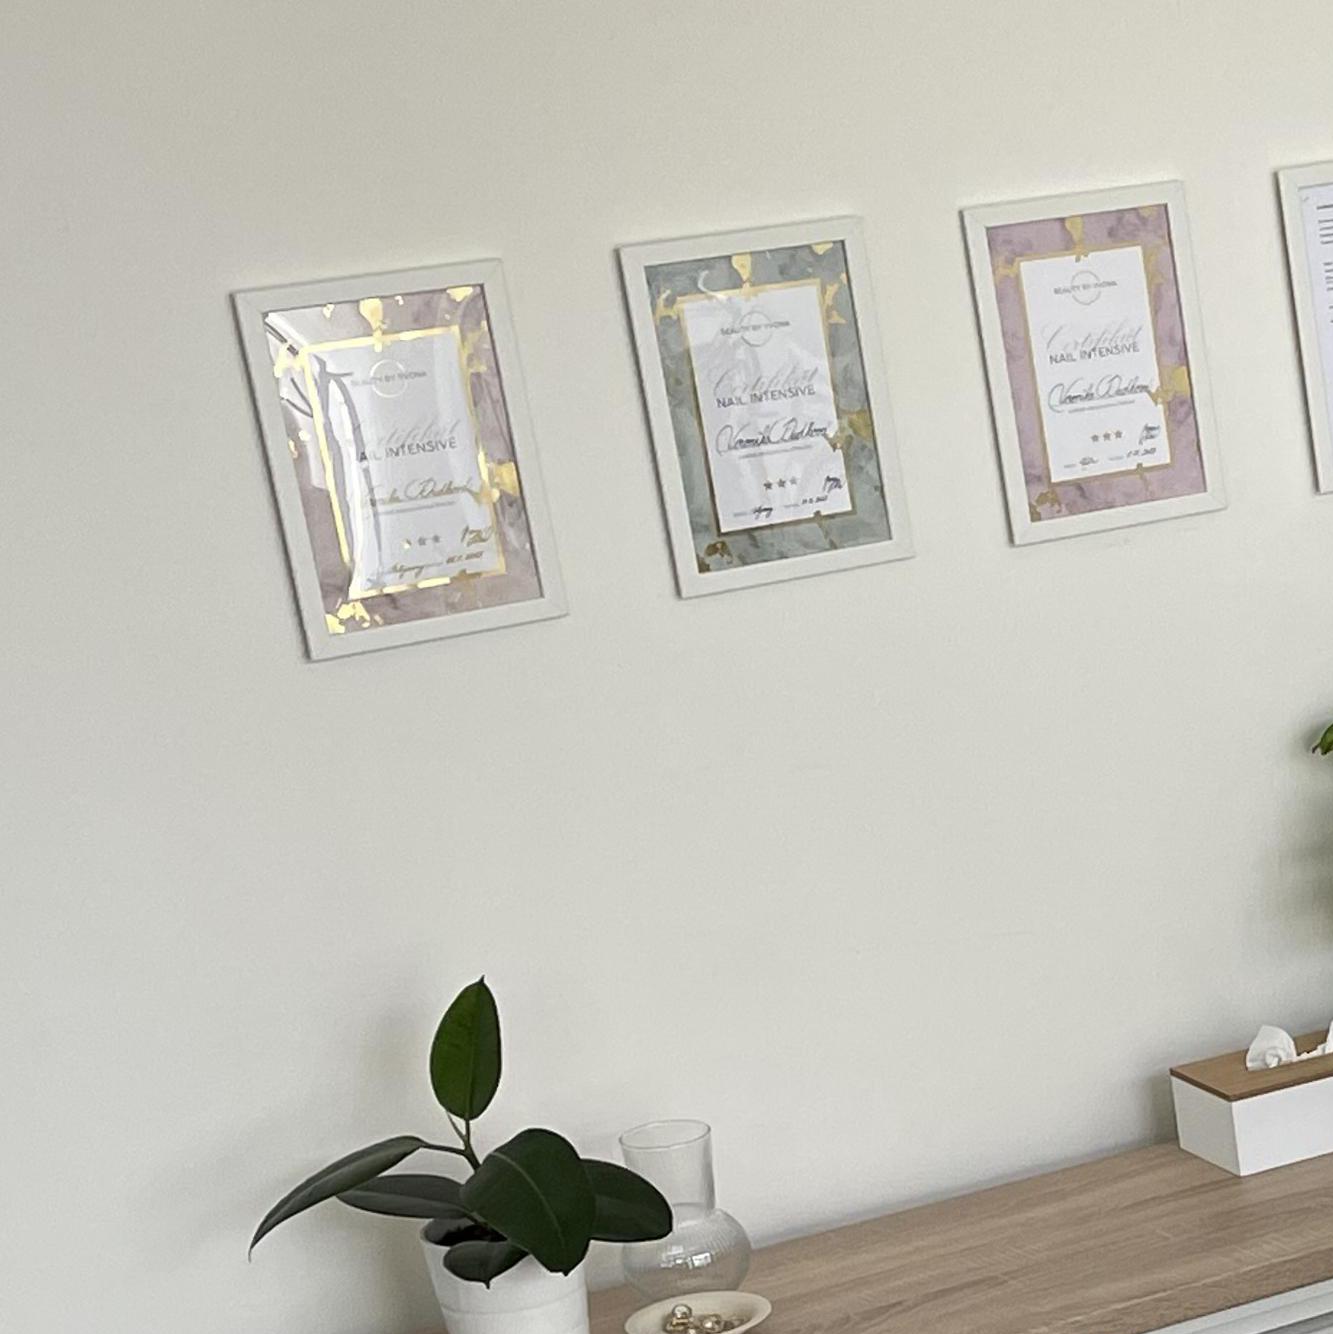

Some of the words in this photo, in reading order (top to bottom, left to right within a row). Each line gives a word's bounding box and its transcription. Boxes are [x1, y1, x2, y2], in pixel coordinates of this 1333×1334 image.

[1049, 352, 1077, 365] NAIL
[1080, 341, 1140, 360] INTENSIVE
[716, 396, 747, 408] NAIL
[750, 384, 816, 404] INTENSIVE
[385, 436, 458, 458] INTENSIVE
